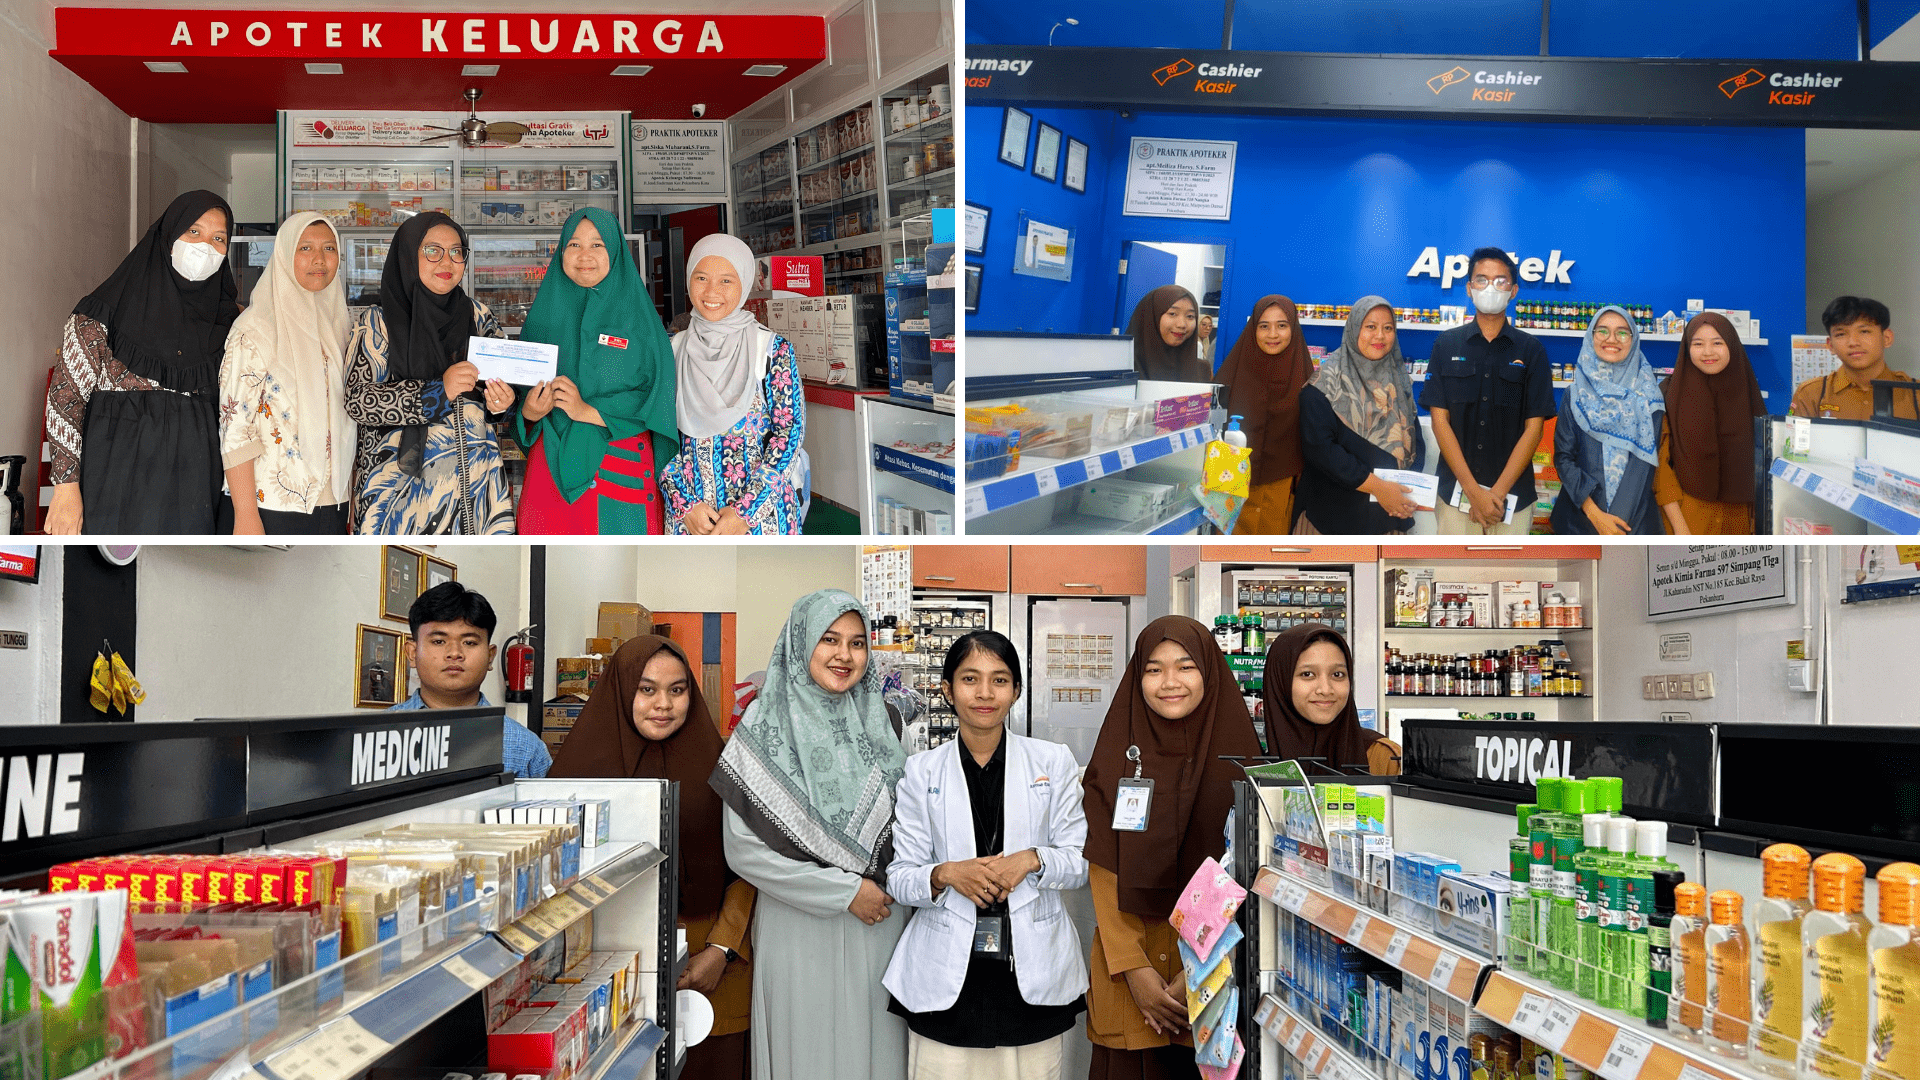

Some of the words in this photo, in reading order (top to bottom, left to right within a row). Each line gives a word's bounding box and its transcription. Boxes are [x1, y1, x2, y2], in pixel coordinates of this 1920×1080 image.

[170, 21, 383, 48] APOTEK
[421, 18, 725, 54] KELUARGA
[1197, 62, 1262, 78] Cashier
[1474, 70, 1542, 86] Cashier
[1194, 80, 1237, 94] Kasir
[1769, 72, 1843, 88] Cashier
[1472, 88, 1516, 102] Kasir
[1768, 90, 1816, 106] Kasir
[539, 129, 575, 137] Apoteker
[1157, 148, 1188, 157] PRAKTIK
[1189, 149, 1227, 159] APOTEKER
[786, 260, 810, 274] Sutra
[884, 454, 896, 464] Atasi
[896, 456, 911, 470] Kebas,
[912, 462, 939, 478] Kesemutan
[1656, 564, 1670, 572] Senin
[1701, 553, 1716, 564] Pukul
[1721, 549, 1737, 560] 08.00
[1742, 545, 1758, 556] 15.00
[1653, 575, 1673, 588] Apotek
[1675, 572, 1693, 583] Kimia
[1694, 568, 1716, 580] Farma
[1718, 565, 1728, 575] 597
[1730, 559, 1761, 573] Simpang
[1762, 555, 1779, 568] Tiga
[1693, 583, 1704, 593] NST
[1751, 573, 1766, 584] Raya
[3, 634, 27, 646] TUNGGU
[351, 725, 451, 786] MEDICINE
[1475, 735, 1576, 787] TOPICAL
[56, 907, 75, 985] Panadol
